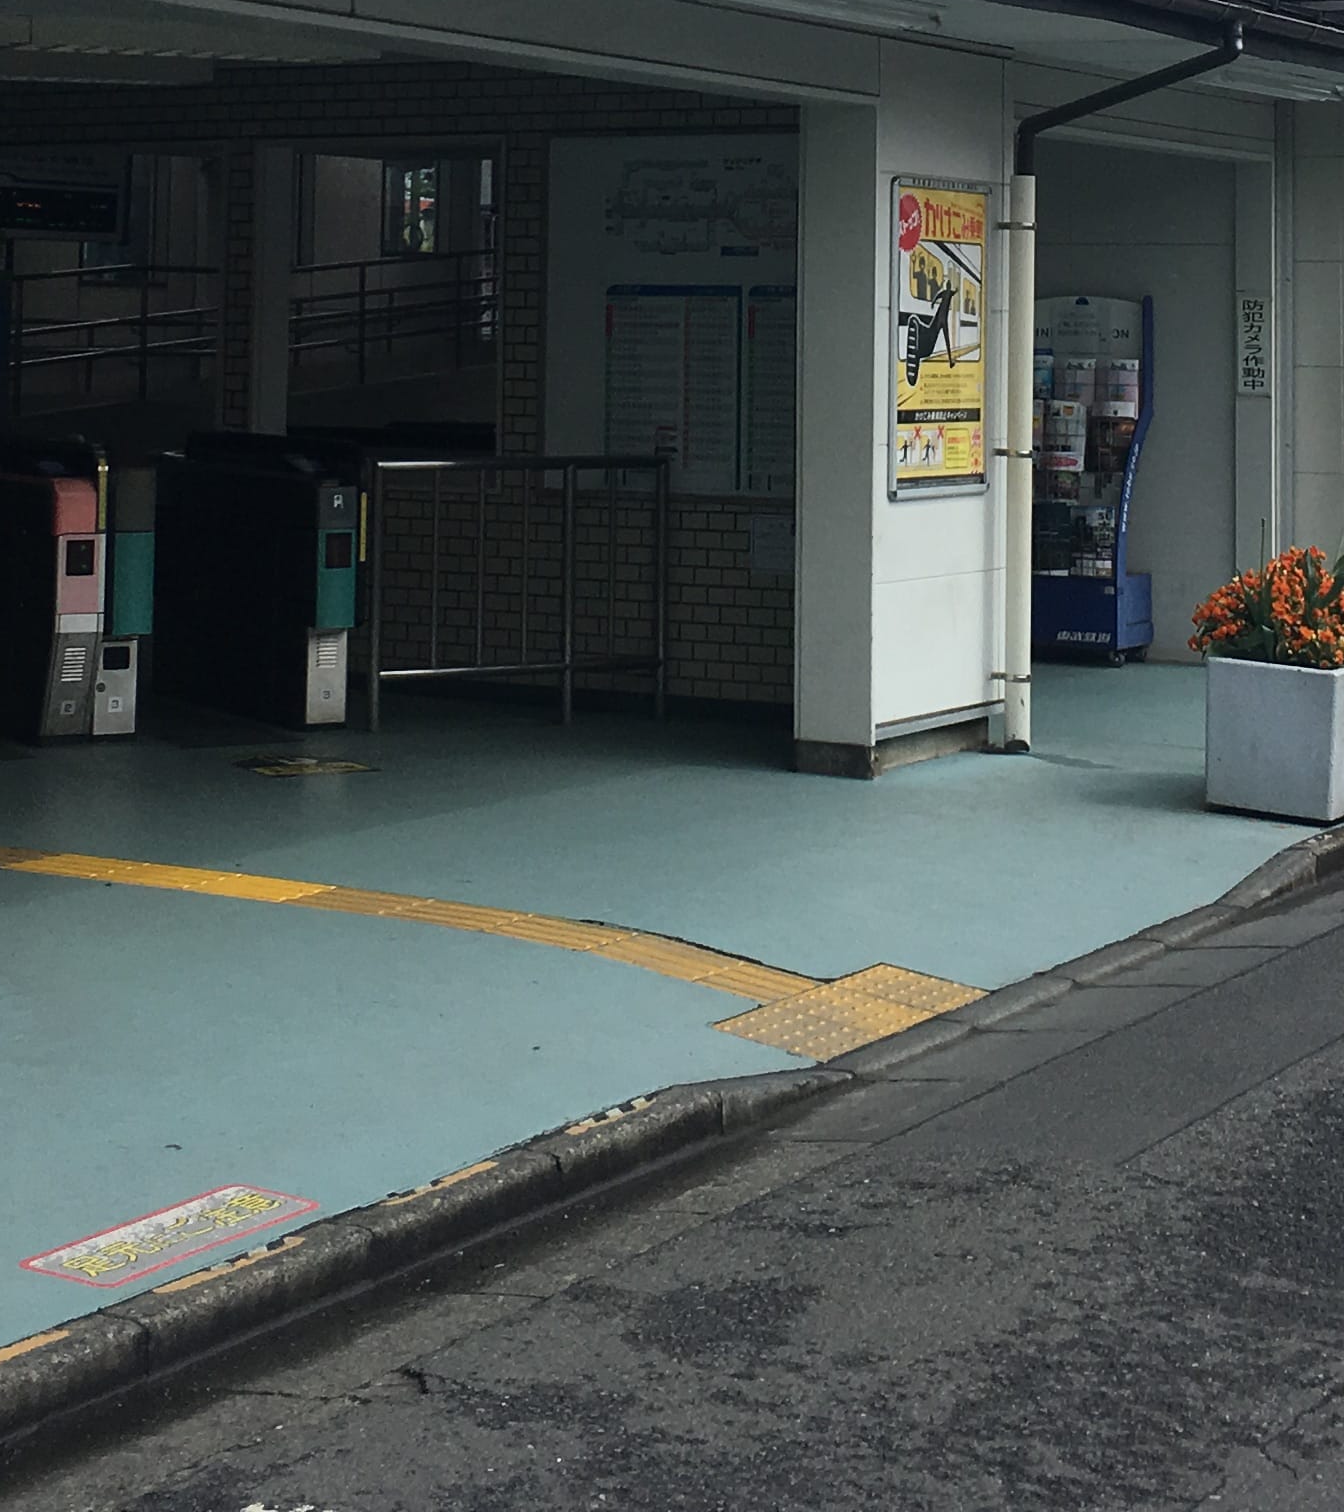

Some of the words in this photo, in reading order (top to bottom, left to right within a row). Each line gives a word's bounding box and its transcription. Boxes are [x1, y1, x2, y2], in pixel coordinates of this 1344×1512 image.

[1241, 299, 1265, 390] 防犯カメラ作動中
